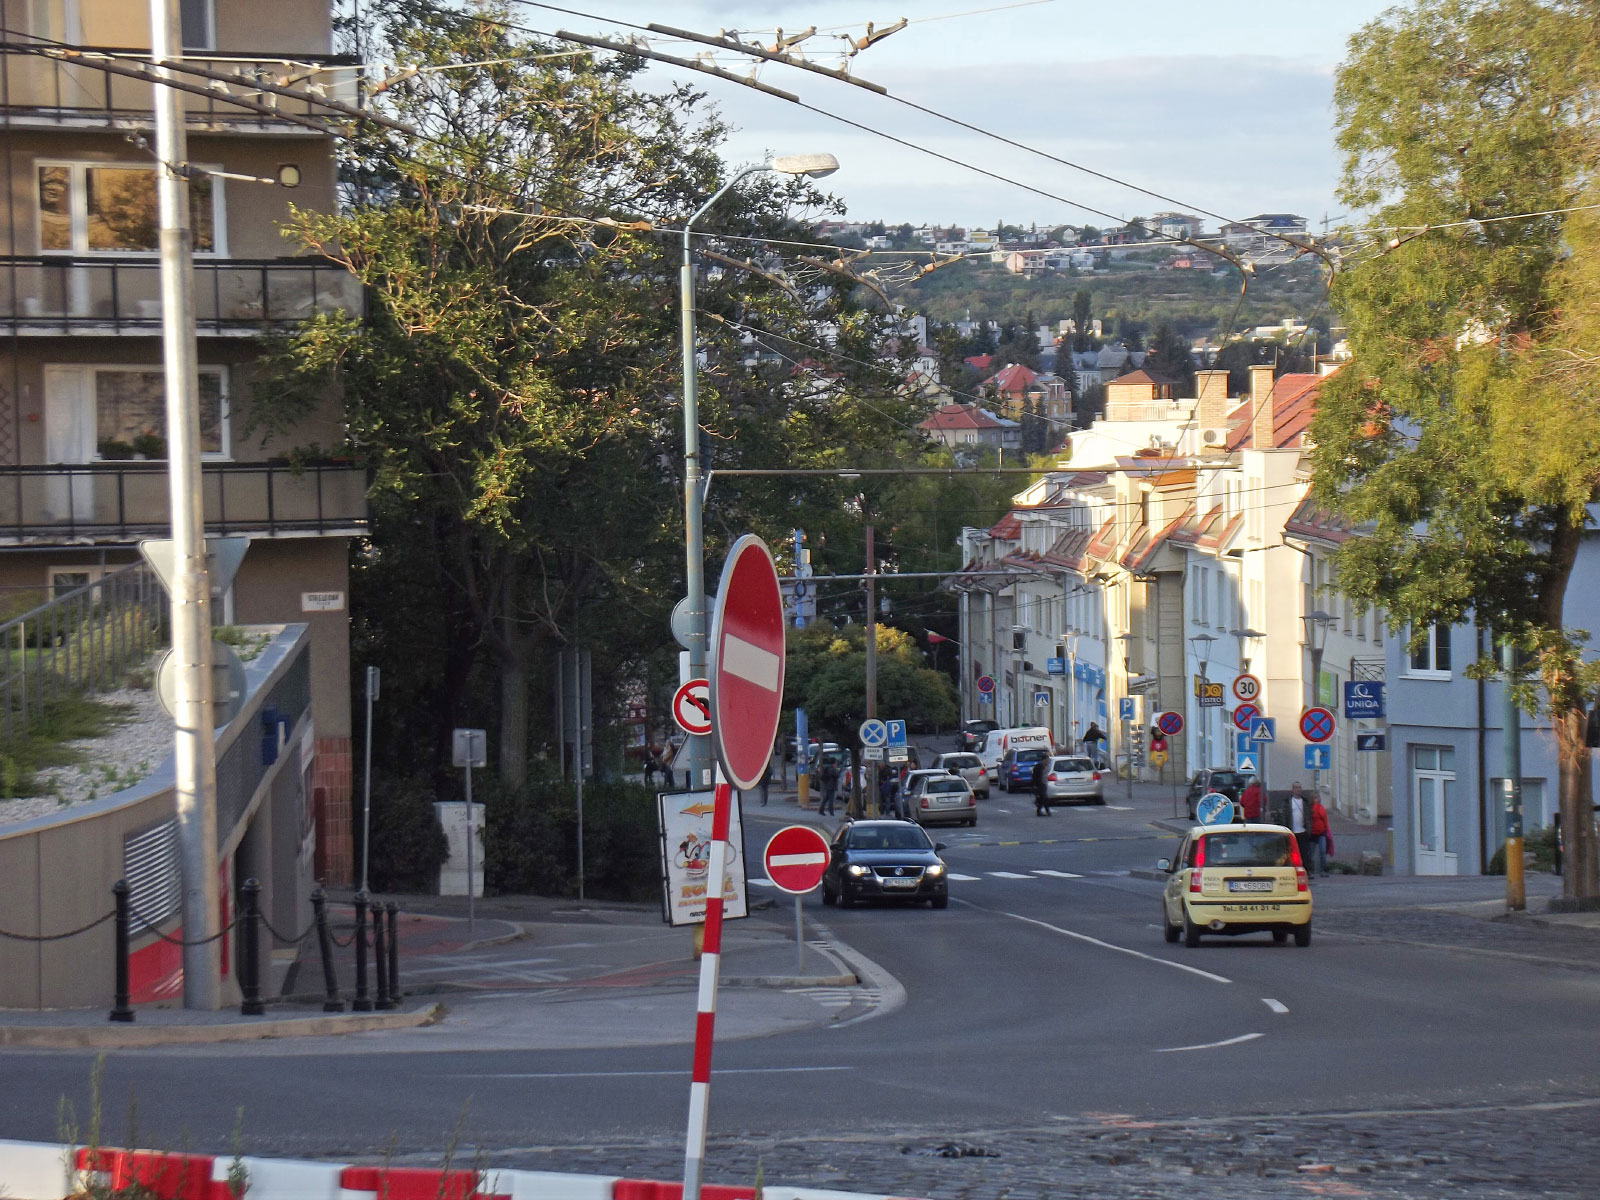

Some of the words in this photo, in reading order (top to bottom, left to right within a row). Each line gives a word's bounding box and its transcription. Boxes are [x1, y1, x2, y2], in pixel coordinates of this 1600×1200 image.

[1240, 682, 1254, 694] 30
[1123, 698, 1131, 711] P
[1347, 700, 1379, 708] UNIQA
[892, 723, 900, 737] P
